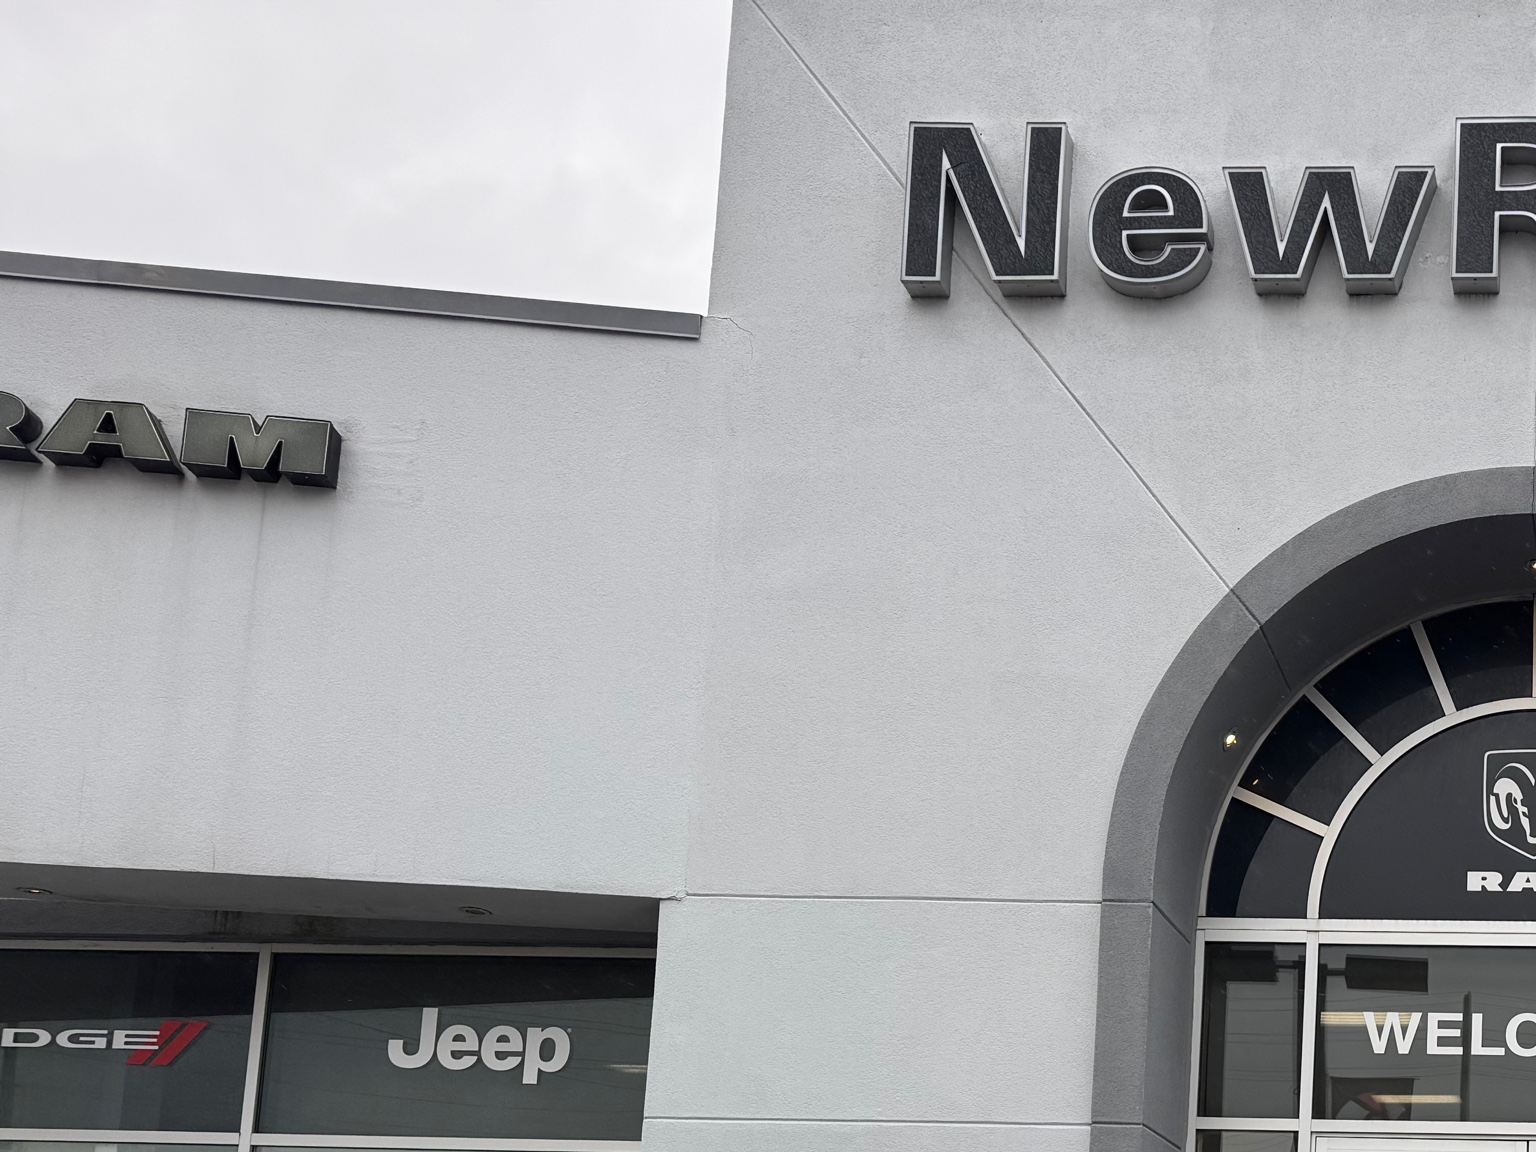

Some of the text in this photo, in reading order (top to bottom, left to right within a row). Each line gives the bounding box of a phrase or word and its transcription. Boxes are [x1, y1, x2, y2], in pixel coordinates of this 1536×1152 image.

[0, 391, 341, 488] AM
[1, 1028, 160, 1050] DGE
[388, 1007, 571, 1084] Jeep
